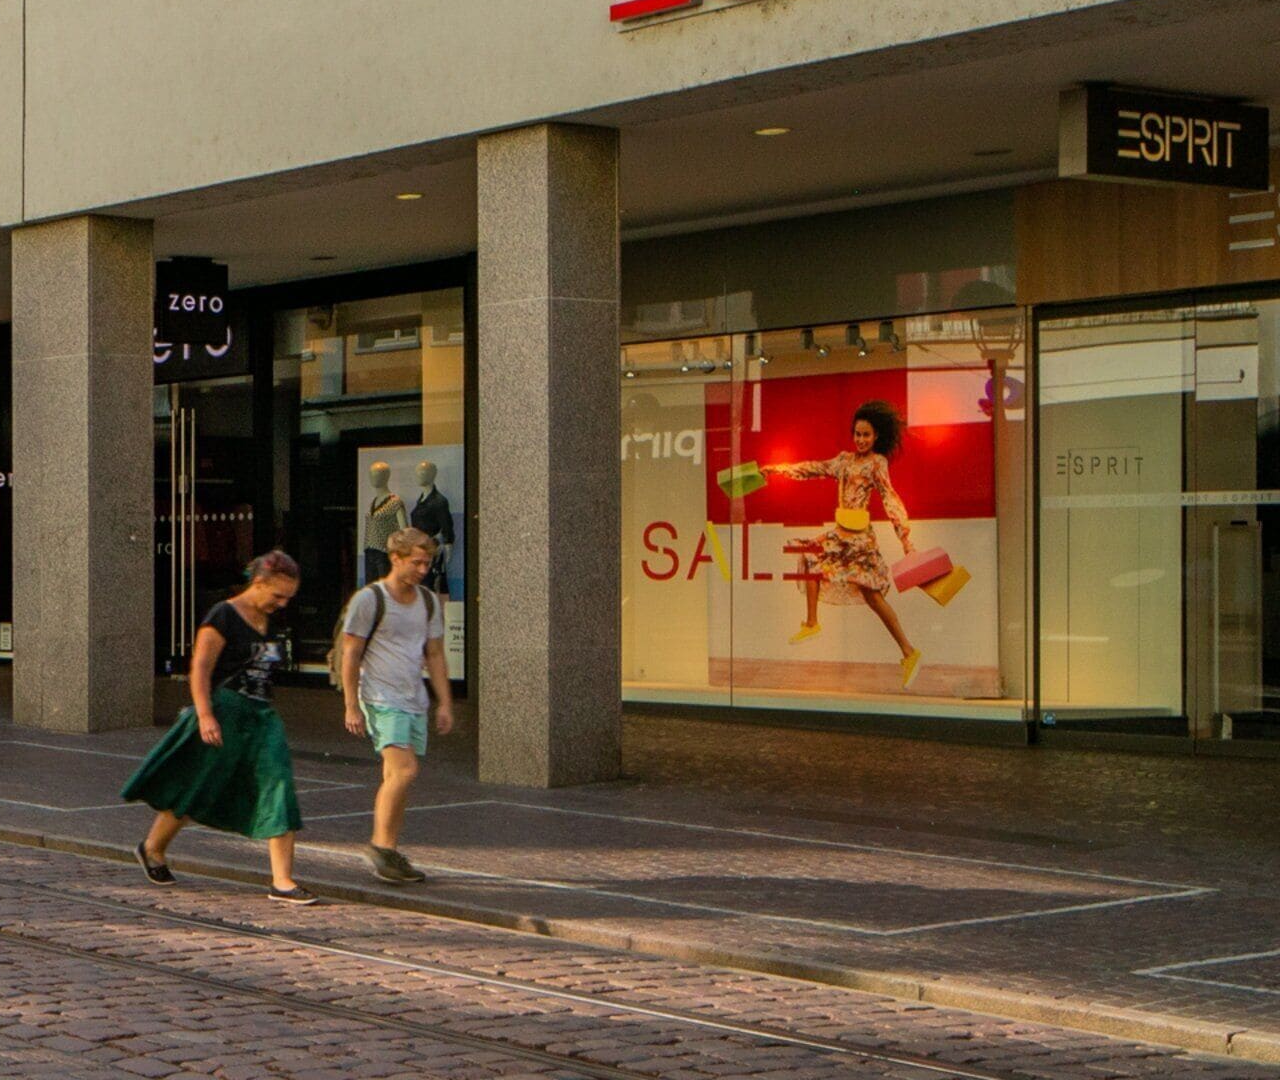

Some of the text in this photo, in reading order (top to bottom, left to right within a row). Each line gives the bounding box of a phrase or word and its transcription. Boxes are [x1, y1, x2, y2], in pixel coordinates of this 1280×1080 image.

[1117, 109, 1241, 169] ESPRIT
[168, 293, 224, 313] zero
[1056, 456, 1144, 476] ESPRIT
[641, 521, 824, 581] SALE
